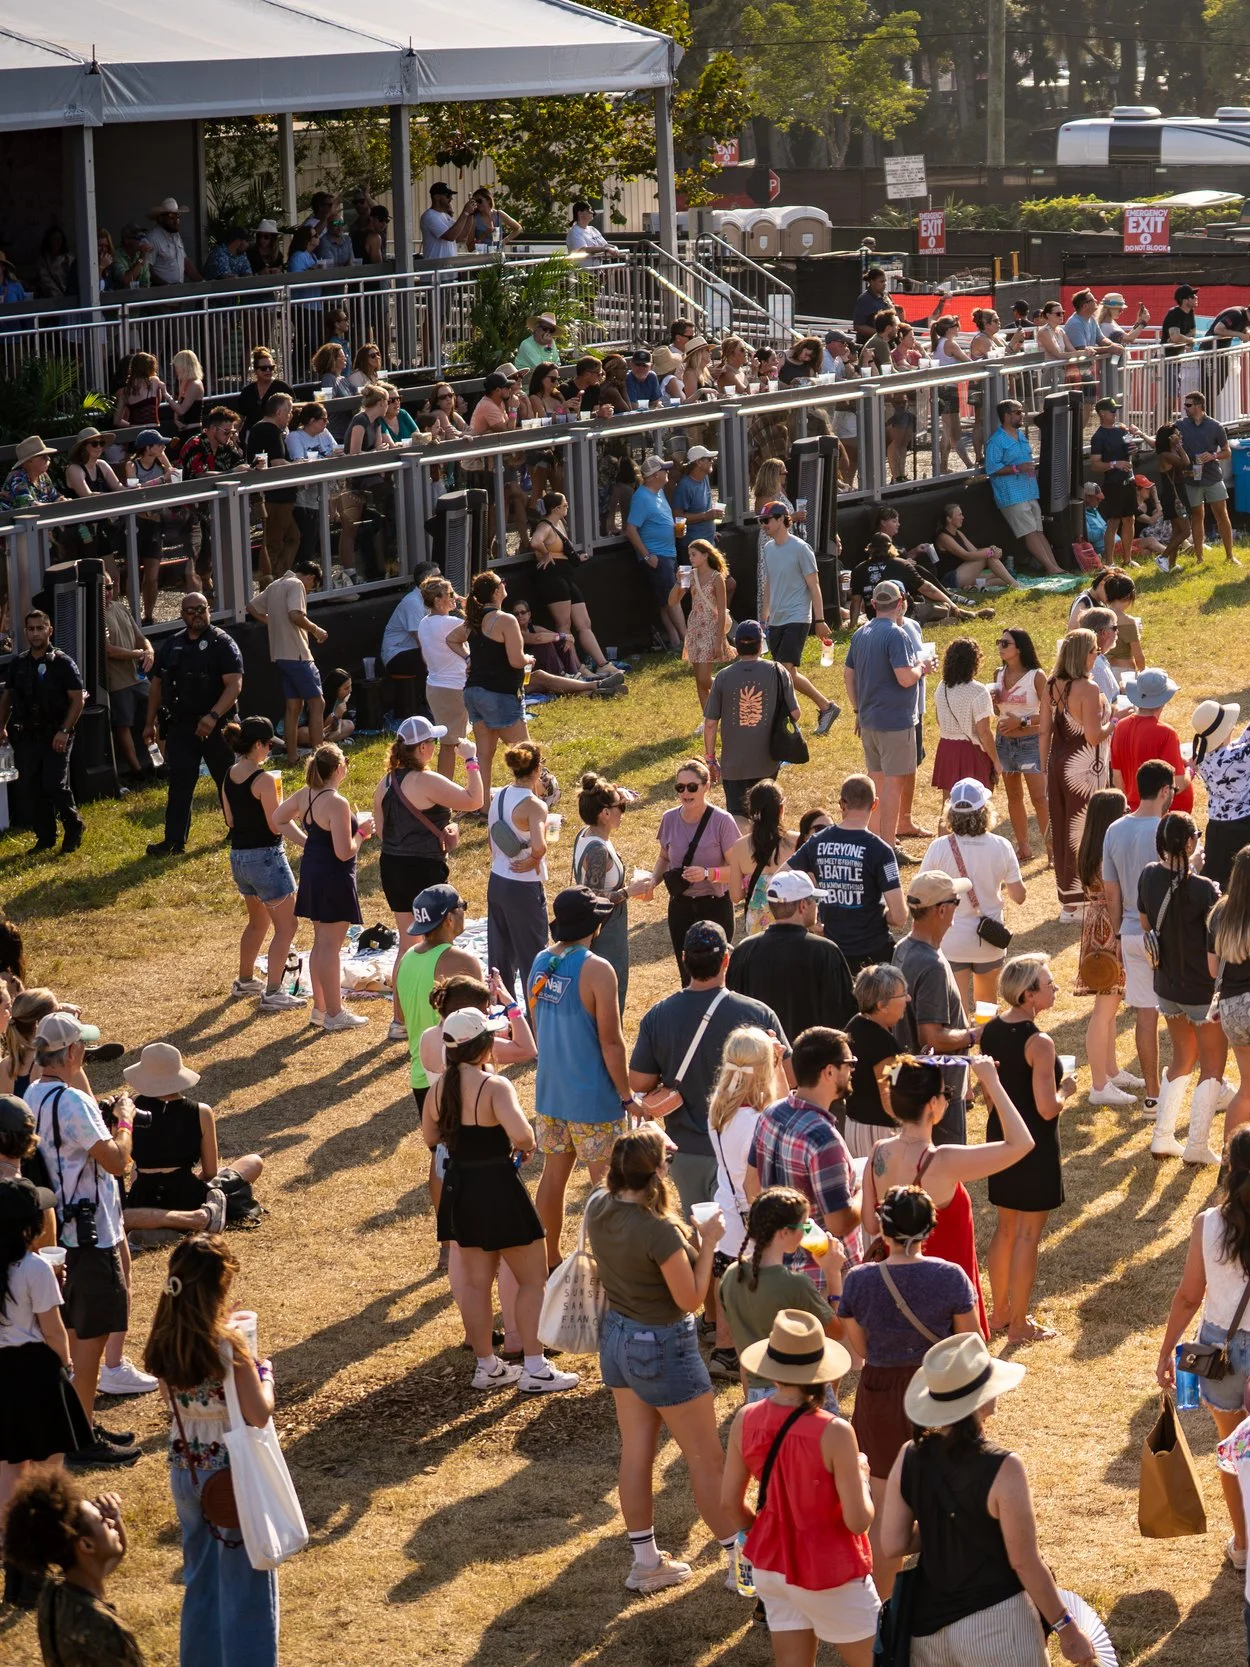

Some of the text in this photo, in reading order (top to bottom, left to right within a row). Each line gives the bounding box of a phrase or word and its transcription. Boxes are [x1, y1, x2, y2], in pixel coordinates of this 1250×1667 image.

[919, 211, 944, 220] EMERGENCY
[1125, 208, 1168, 217] EMERGENCY
[921, 219, 943, 237] EXIT
[1128, 216, 1166, 233] EXIT
[817, 842, 866, 859] EVERYONE
[824, 865, 863, 882] BATTLE
[413, 907, 431, 923] SA
[563, 1302, 583, 1311] SAN
